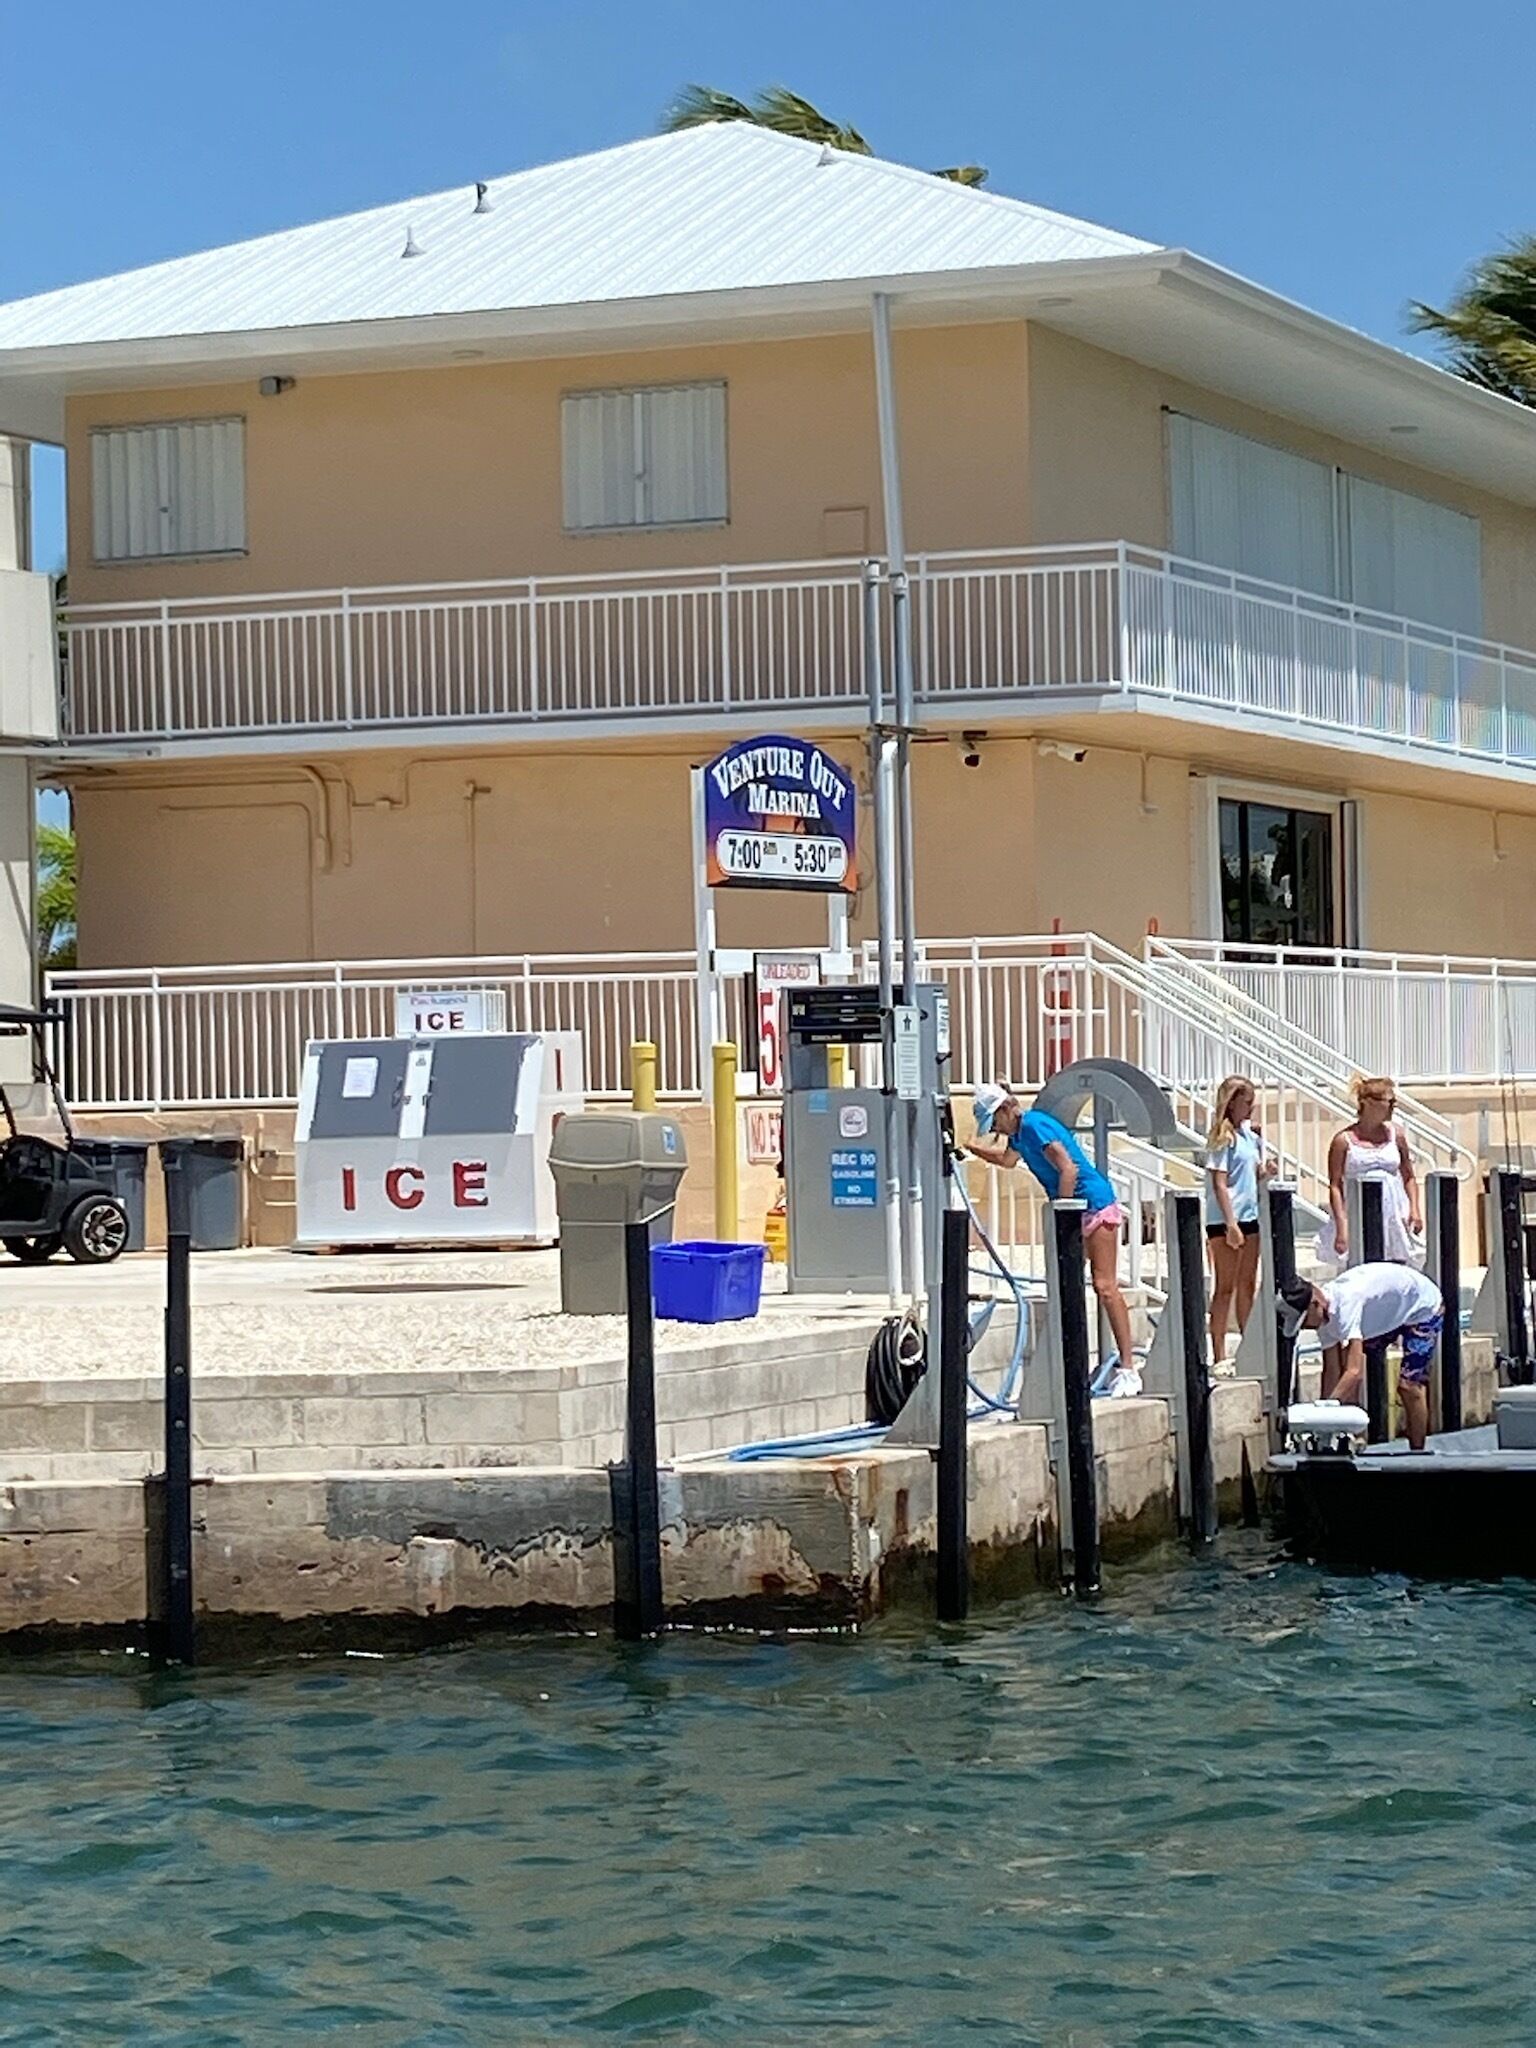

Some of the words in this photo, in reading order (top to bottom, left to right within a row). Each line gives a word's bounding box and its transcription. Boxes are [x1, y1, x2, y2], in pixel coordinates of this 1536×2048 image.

[711, 746, 805, 799] VENTURE
[809, 750, 847, 811] OUT
[747, 782, 821, 819] MARINA
[728, 838, 761, 869] 7:00
[794, 844, 826, 873] 5:30
[415, 1010, 465, 1032] ICE
[831, 1153, 858, 1166] REC
[860, 1153, 876, 1166] 90
[341, 1161, 489, 1211] ICE
[846, 1184, 861, 1194] NO
